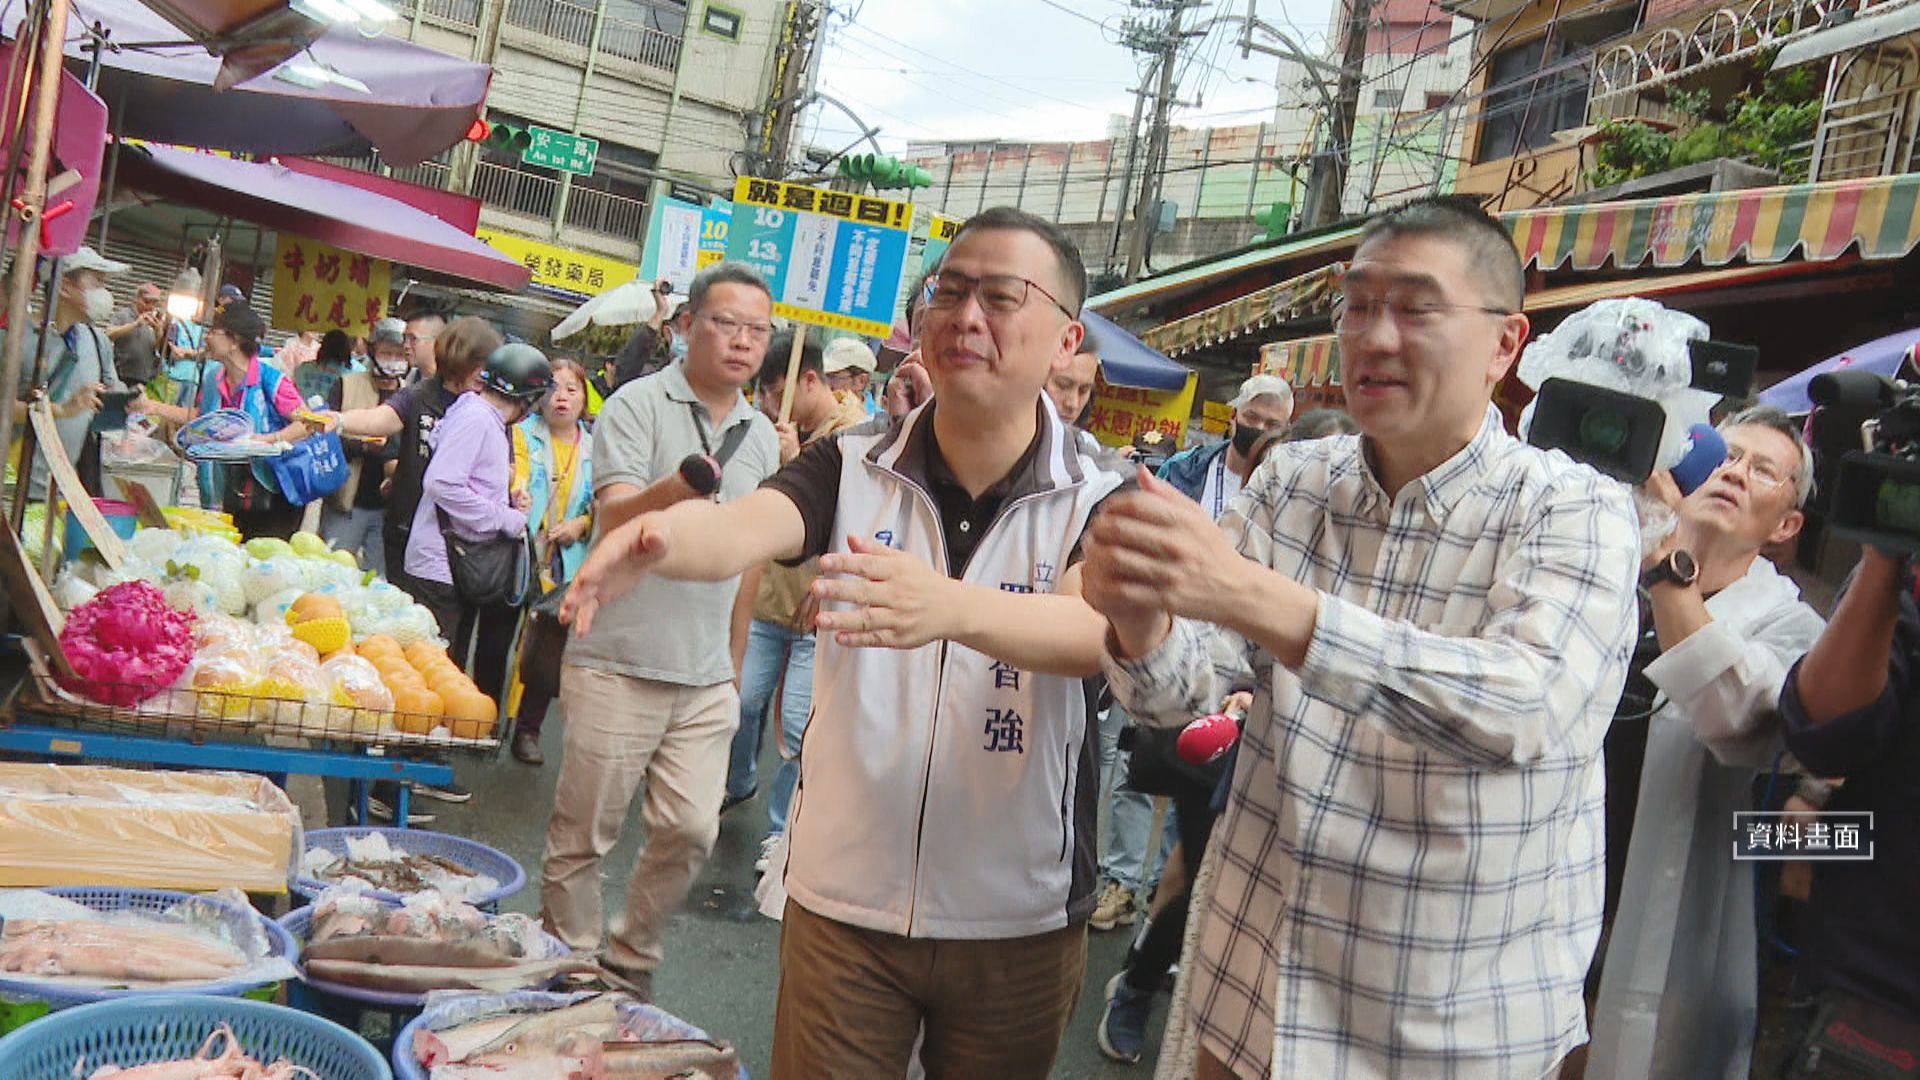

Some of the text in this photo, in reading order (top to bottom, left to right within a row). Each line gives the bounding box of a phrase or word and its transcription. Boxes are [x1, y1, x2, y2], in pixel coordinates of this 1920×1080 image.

[536, 131, 588, 156] 安一路
[532, 151, 547, 162] An
[753, 206, 785, 229] 10
[701, 219, 729, 241] 10
